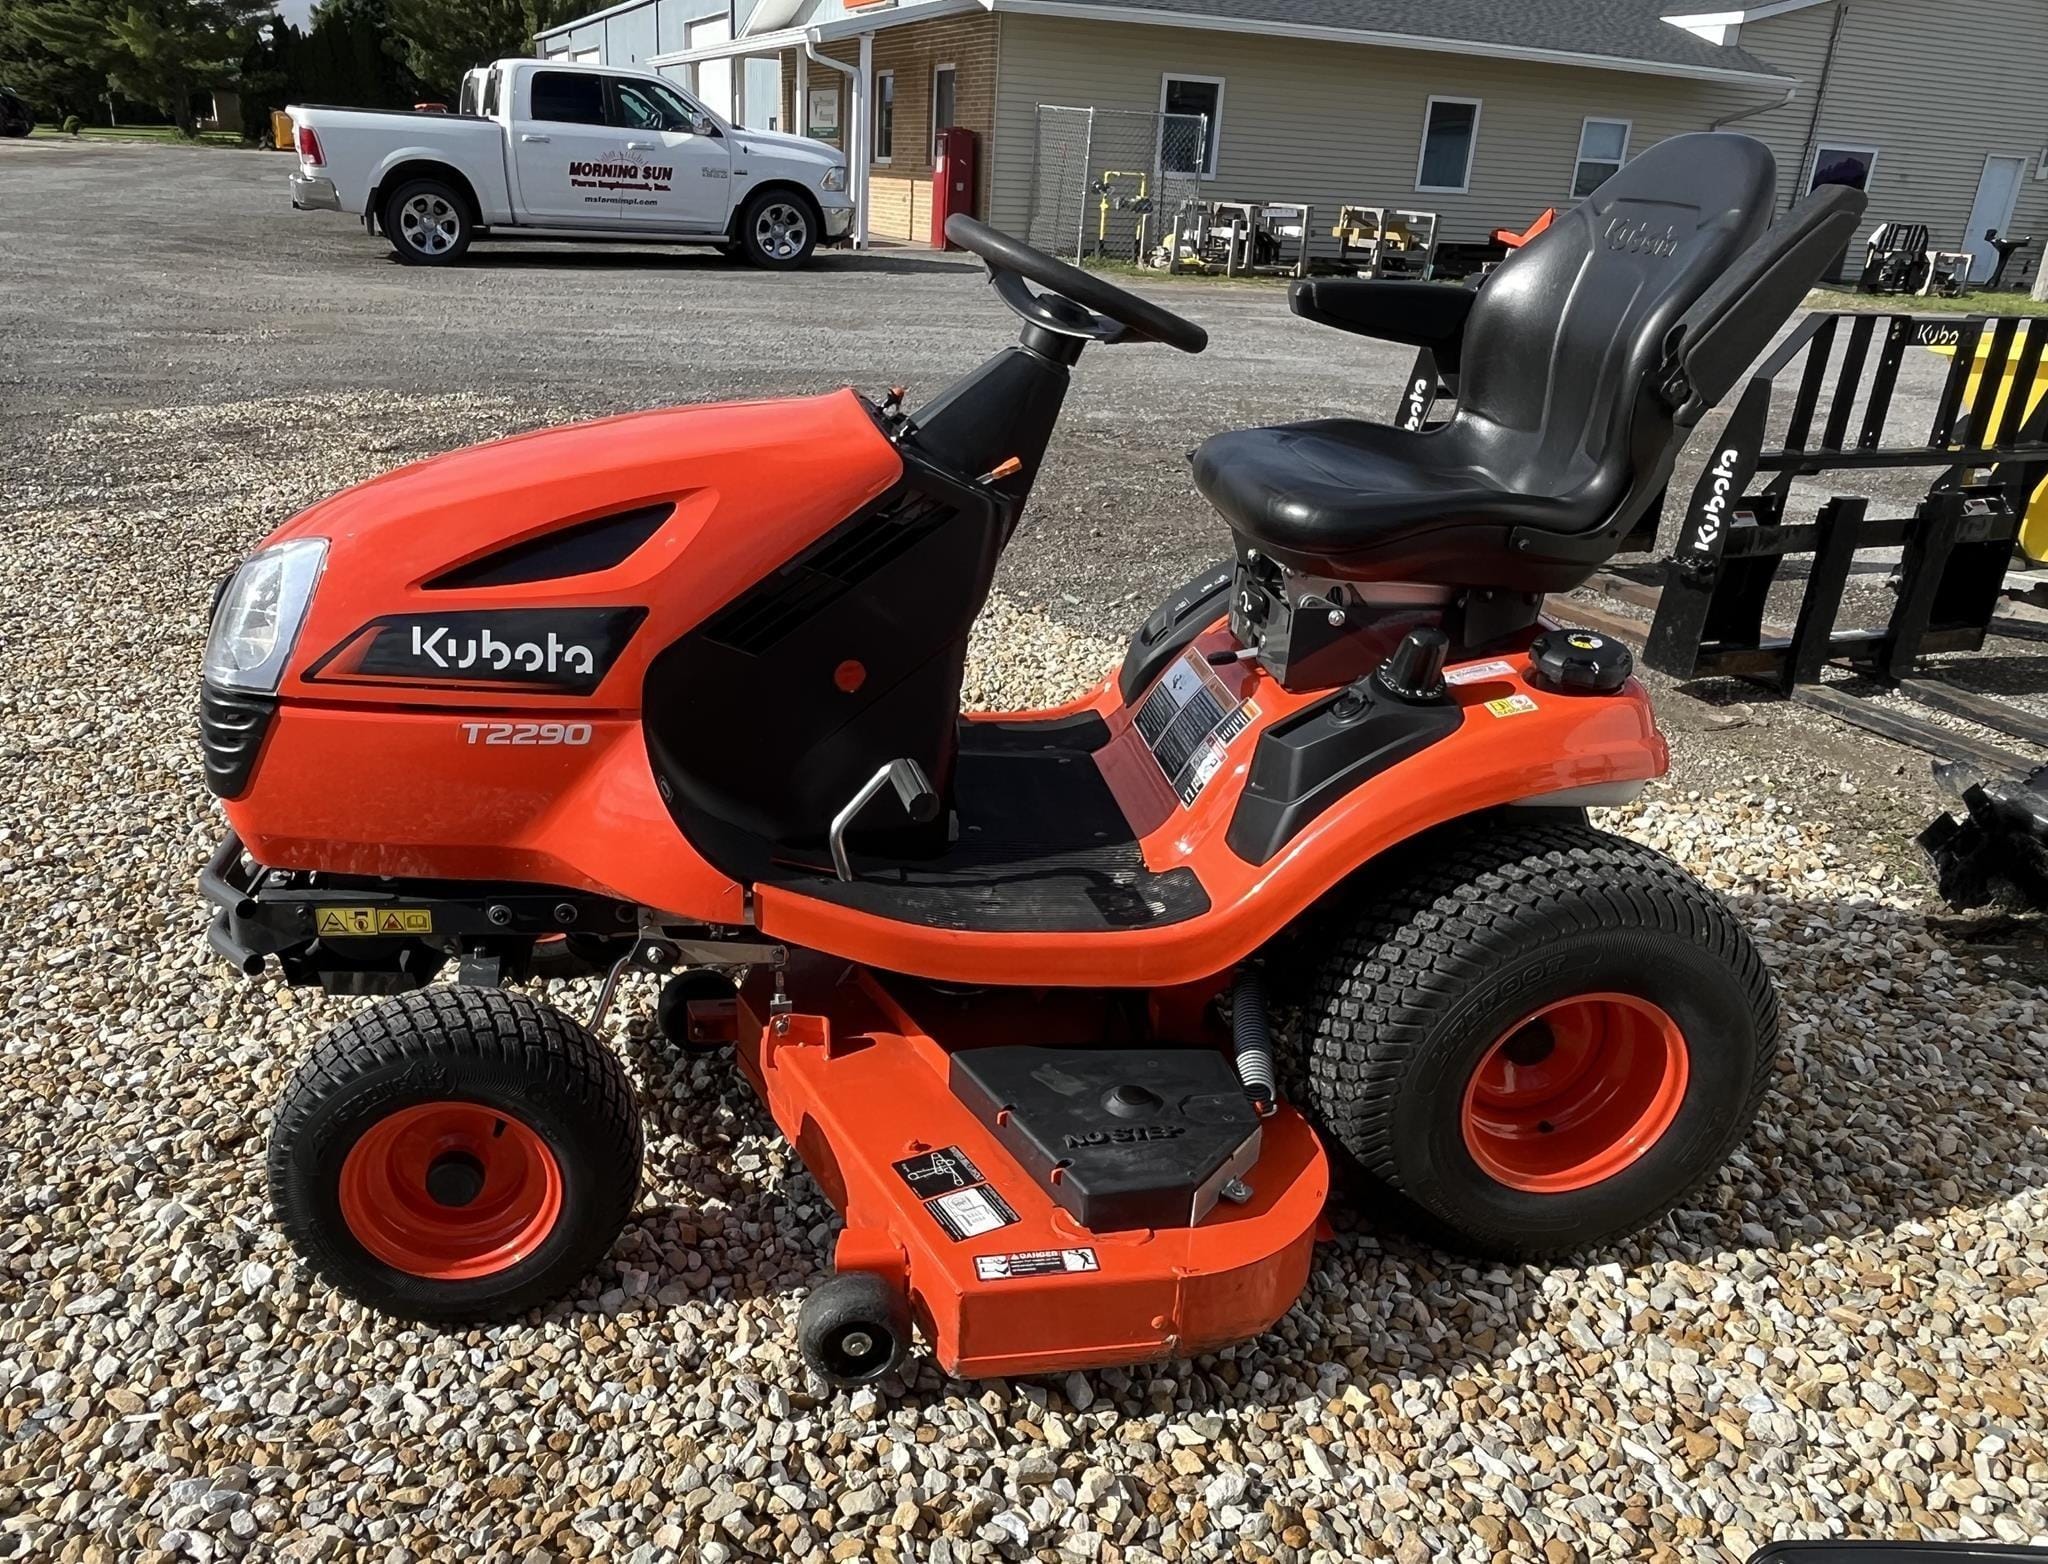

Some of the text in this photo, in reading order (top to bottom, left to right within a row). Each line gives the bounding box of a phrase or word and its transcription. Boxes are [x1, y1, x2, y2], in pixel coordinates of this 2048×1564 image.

[569, 162, 673, 181] MORNING SUN
[1917, 324, 1960, 345] Kubo
[1404, 378, 1427, 432] bota
[1694, 449, 1738, 551] Kubota
[412, 626, 593, 674] Kubota
[462, 723, 593, 745] T2290
[1062, 1131, 1111, 1151] NO
